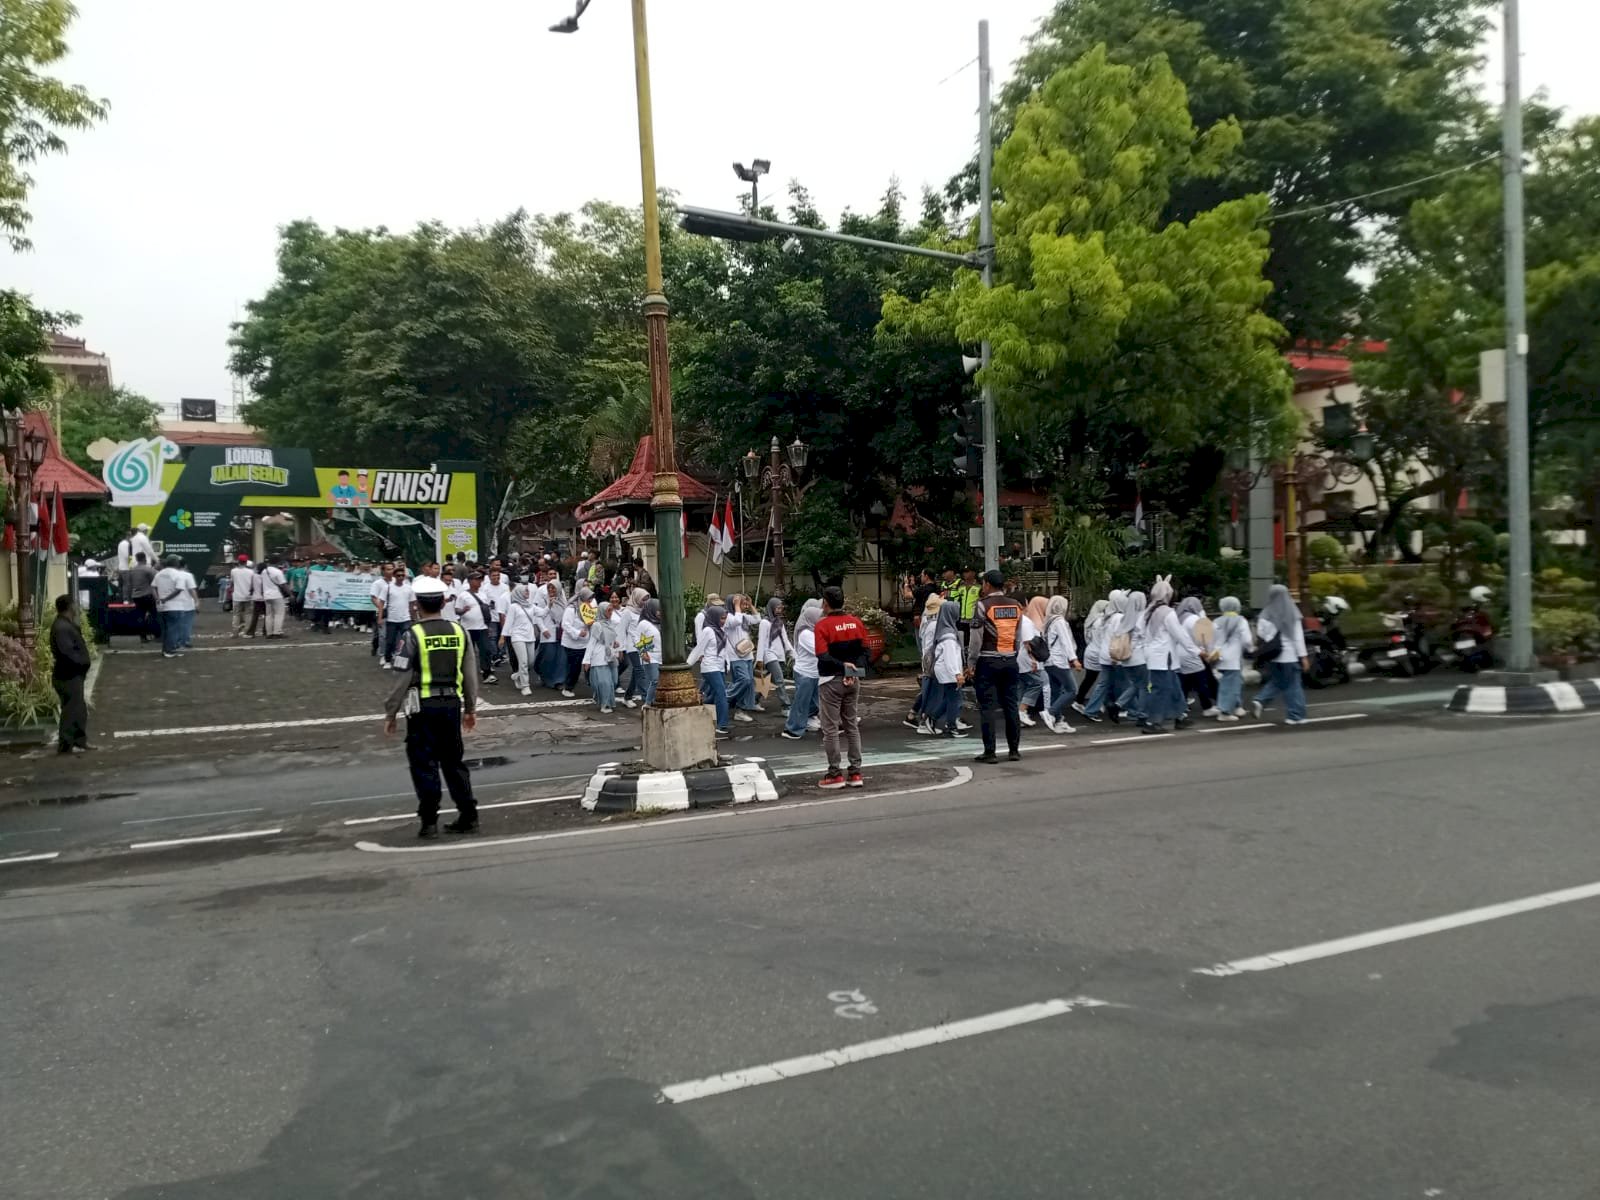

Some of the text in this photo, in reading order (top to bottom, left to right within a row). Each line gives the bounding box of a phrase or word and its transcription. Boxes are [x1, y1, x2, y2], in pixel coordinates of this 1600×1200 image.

[227, 448, 272, 464] LOMBA
[212, 465, 286, 485] JALAN SEHAT
[372, 472, 450, 502] FINISH
[424, 637, 460, 649] POLISI
